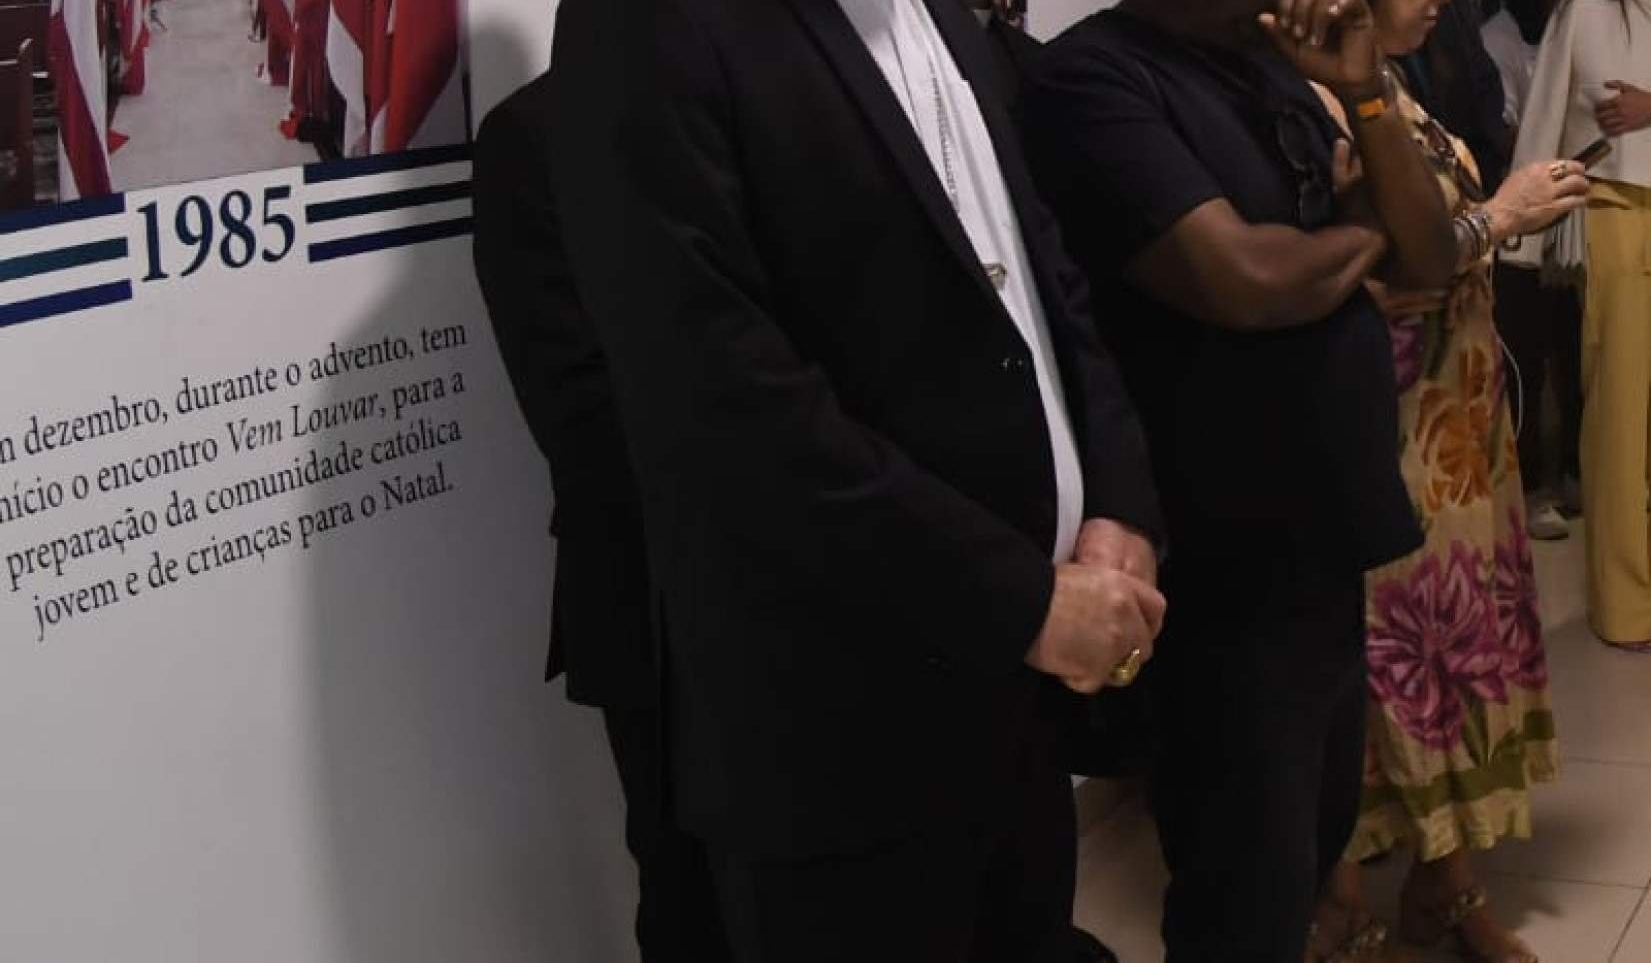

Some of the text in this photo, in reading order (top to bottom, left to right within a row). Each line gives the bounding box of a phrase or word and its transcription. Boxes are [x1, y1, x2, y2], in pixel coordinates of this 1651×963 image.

[138, 185, 297, 282] 1985
[0, 371, 467, 524] nício o encontro Vem Louvar, para a
[24, 395, 168, 455] dezembro,
[176, 366, 278, 414] durante
[286, 363, 301, 386] o
[309, 334, 414, 381] advento,
[421, 324, 468, 353] tem
[6, 418, 462, 592] preparação da comunidade católica
[33, 461, 454, 642] jovem e de crianças para o Natal.
